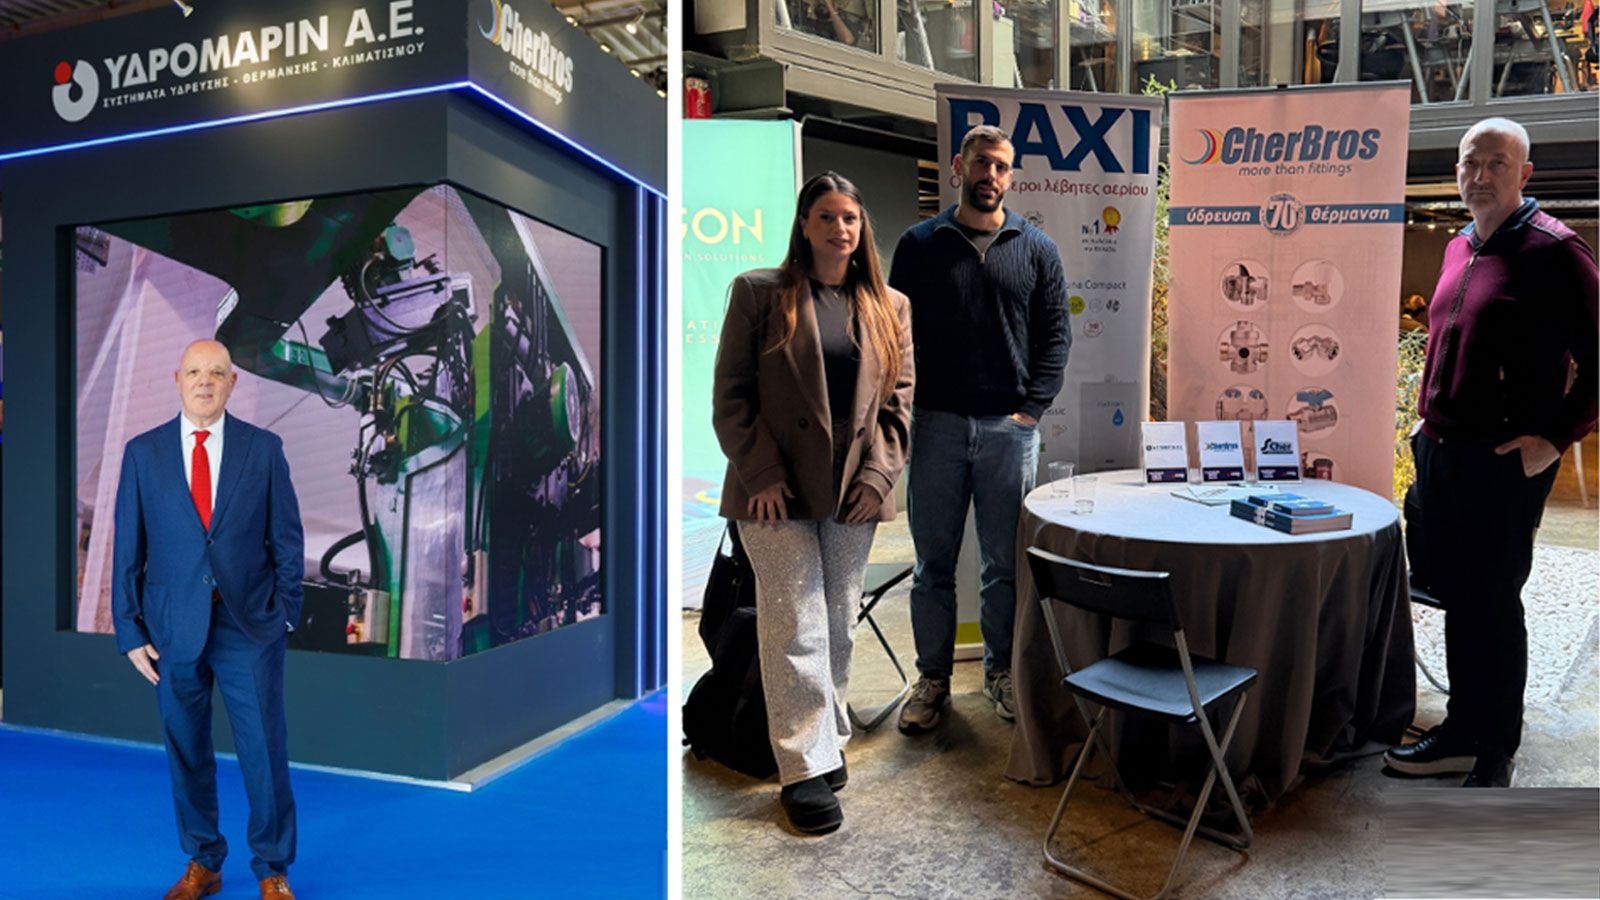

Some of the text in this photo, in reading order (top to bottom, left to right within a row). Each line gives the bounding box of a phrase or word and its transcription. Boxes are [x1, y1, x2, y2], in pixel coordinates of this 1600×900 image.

[103, 0, 425, 90] ΥΔΡΟΜΑΡΙΝ Α.Ε.
[500, 3, 574, 94] CherBros
[102, 88, 167, 108] ΣΥΣΤΗΜΑΤΑ
[170, 76, 230, 96] ΥΔΡΕΥΣΗΣ
[242, 60, 318, 84] ΘΕΡΜΑΝΣΗΣ
[332, 42, 425, 69] ΚΛΙΜΑΤΙΣΜΟΥ
[947, 97, 1151, 175] BAXI
[1221, 125, 1381, 165] CherBros
[1238, 161, 1352, 177] more than fittings
[1010, 180, 1042, 195] εροι
[1044, 178, 1100, 198] λέβητες
[1102, 182, 1150, 197] αερίου
[682, 207, 763, 245] ON
[1186, 207, 1251, 226] ύδρευση
[1269, 200, 1297, 230] 70
[1311, 206, 1390, 222] θέρμανση
[697, 252, 765, 263] SOLUTIONS
[1084, 279, 1127, 292] Compact
